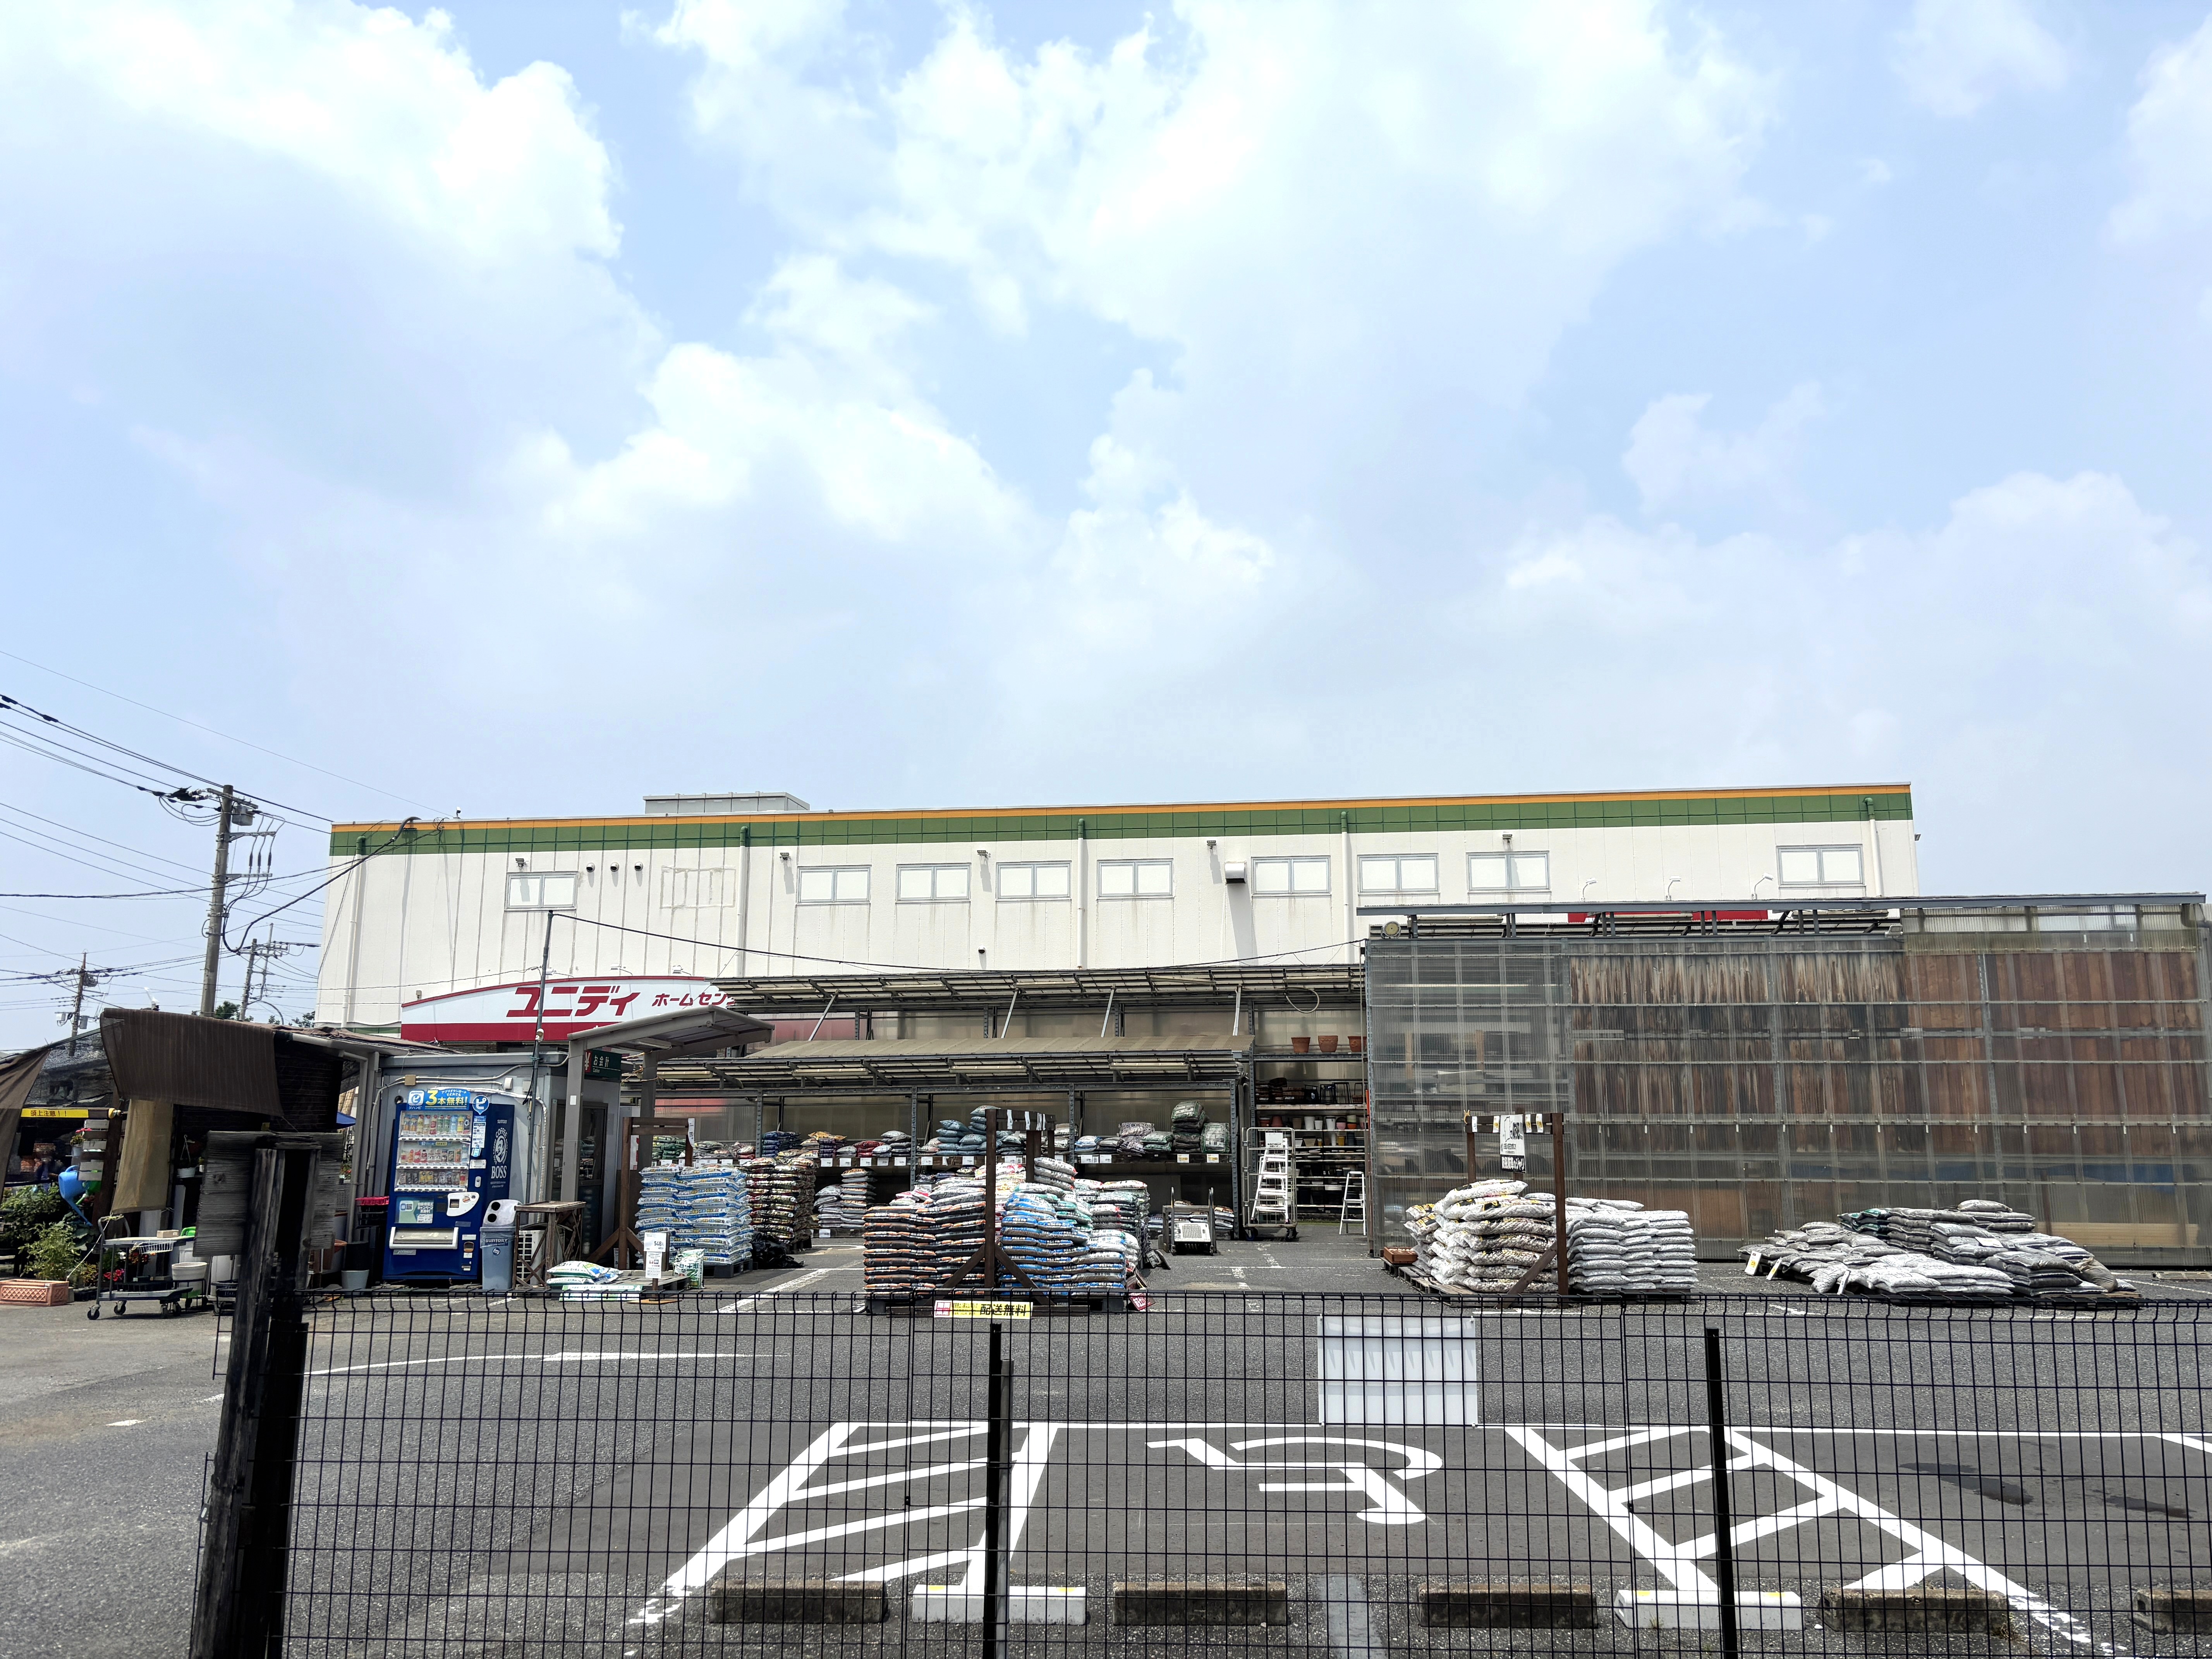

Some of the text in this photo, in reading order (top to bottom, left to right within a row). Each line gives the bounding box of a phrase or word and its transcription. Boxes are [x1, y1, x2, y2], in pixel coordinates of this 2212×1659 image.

[506, 986, 641, 1017] ユニディ
[652, 992, 735, 1006] ホームセン
[593, 1054, 610, 1068] お会計
[495, 1127, 508, 1139] COFFEE
[491, 1165, 507, 1179] BOSS
[980, 1304, 1026, 1316] 配送無料
